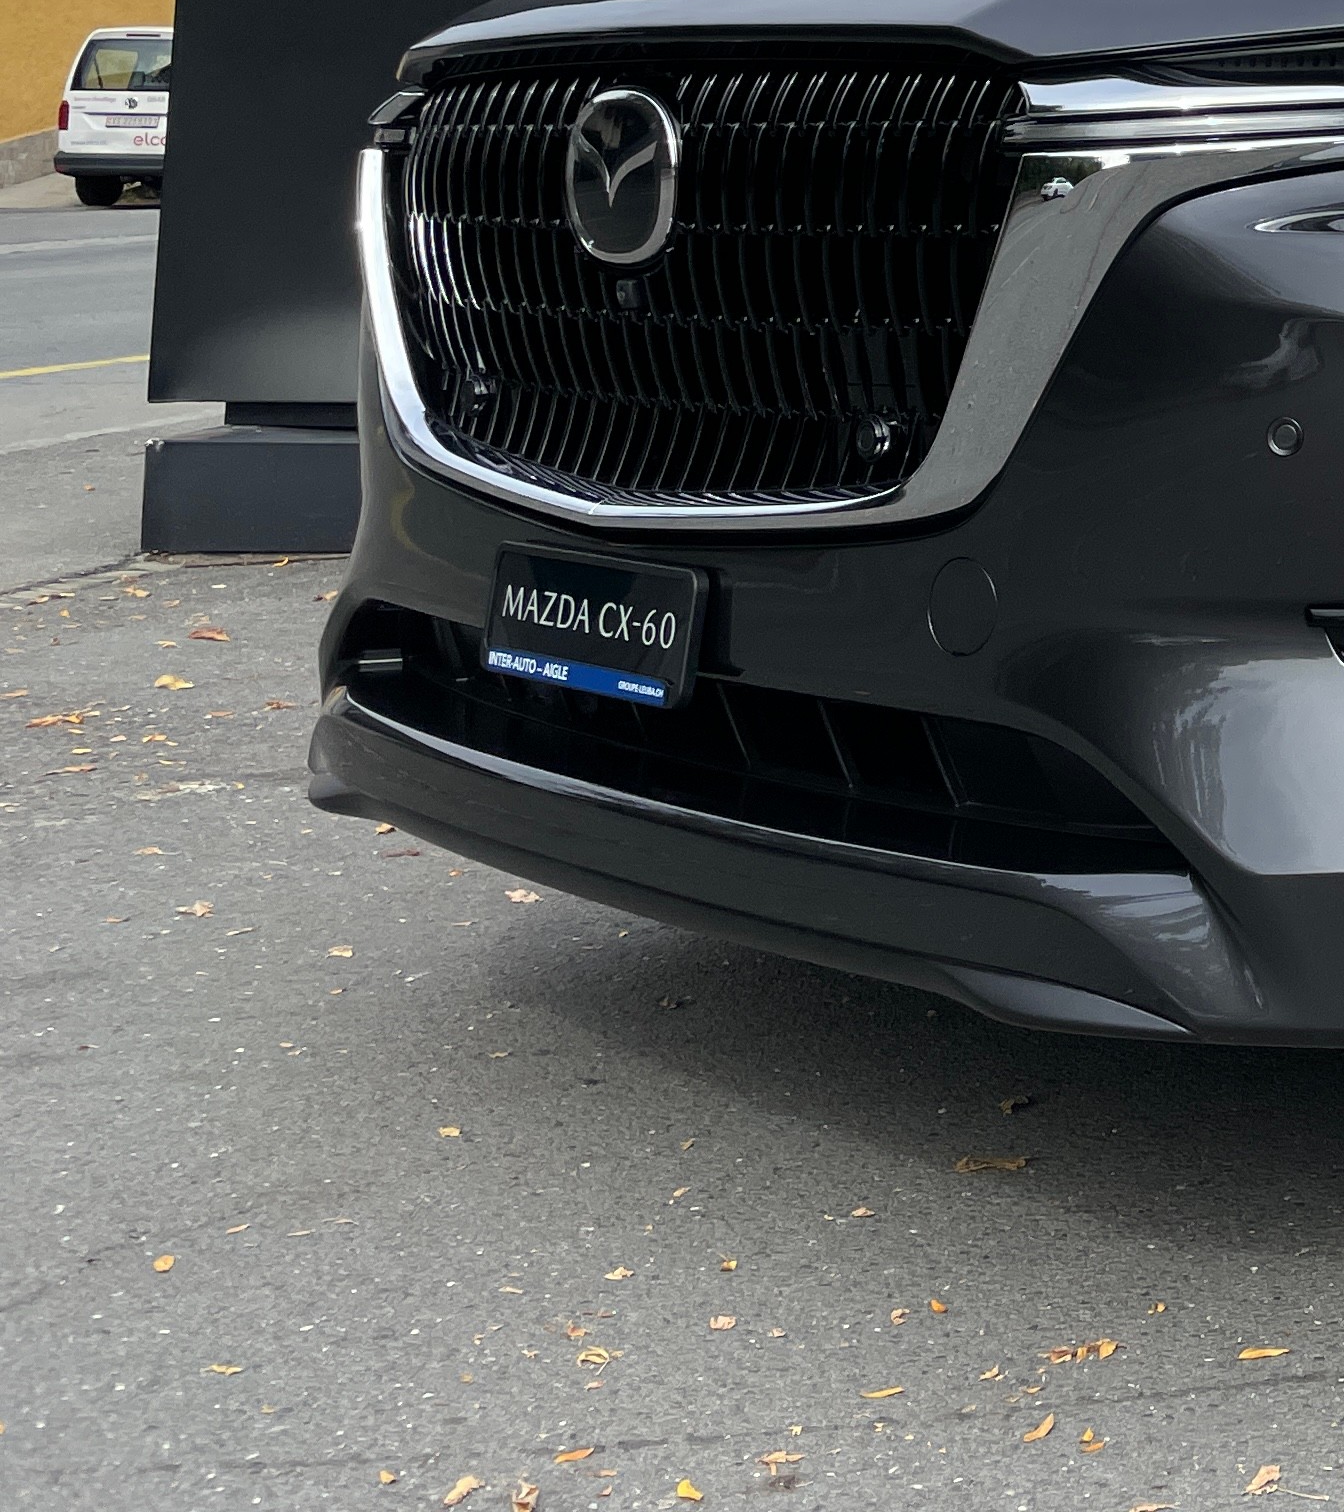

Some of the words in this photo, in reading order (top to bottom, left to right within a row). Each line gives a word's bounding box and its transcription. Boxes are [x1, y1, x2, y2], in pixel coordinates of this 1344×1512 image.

[501, 584, 590, 634] MAZDA
[598, 601, 677, 649] CX-60
[488, 650, 537, 675] INTER-AUTO
[542, 661, 569, 682] AIGLE
